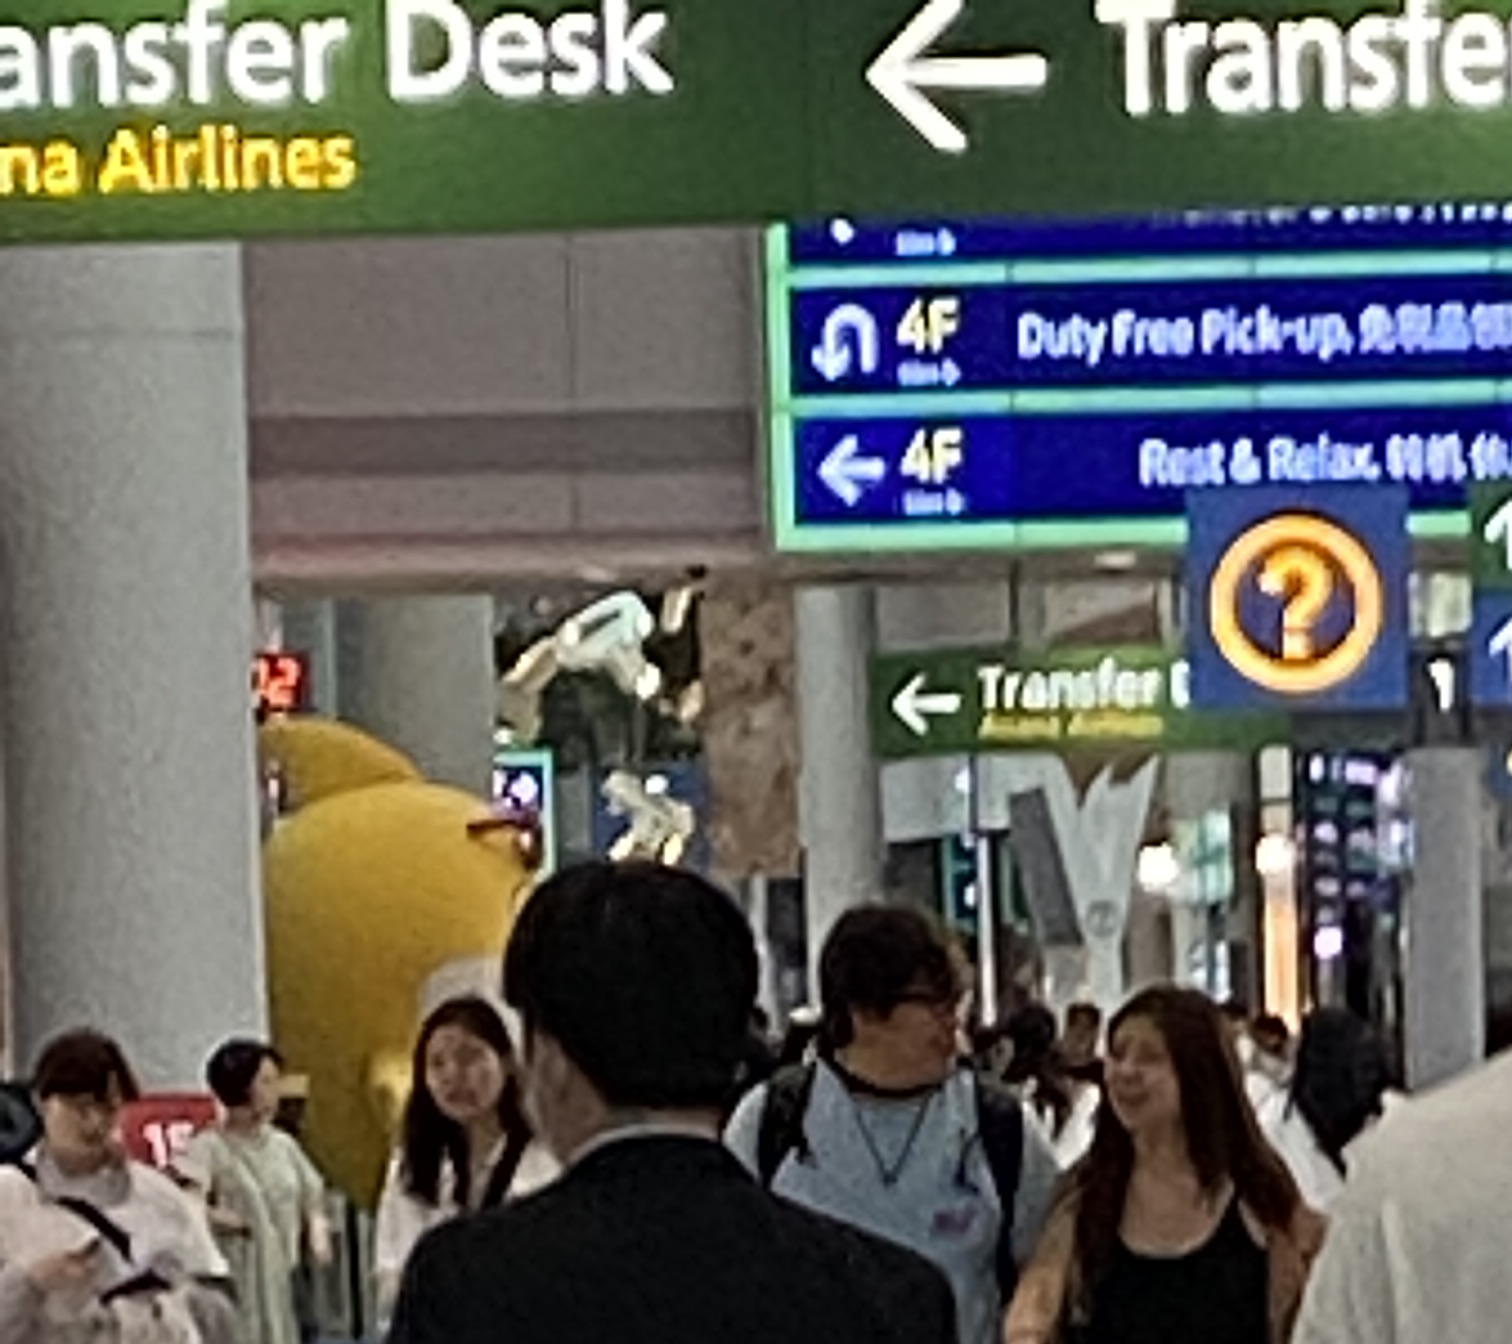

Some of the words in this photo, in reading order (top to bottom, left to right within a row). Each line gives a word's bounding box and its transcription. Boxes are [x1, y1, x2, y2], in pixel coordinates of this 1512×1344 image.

[385, 0, 675, 99] Desk
[98, 124, 358, 194] Airlines
[896, 297, 960, 354] 4F
[1017, 311, 1107, 367] Duty
[900, 427, 963, 485] 4F
[977, 656, 1162, 710] Transfer
